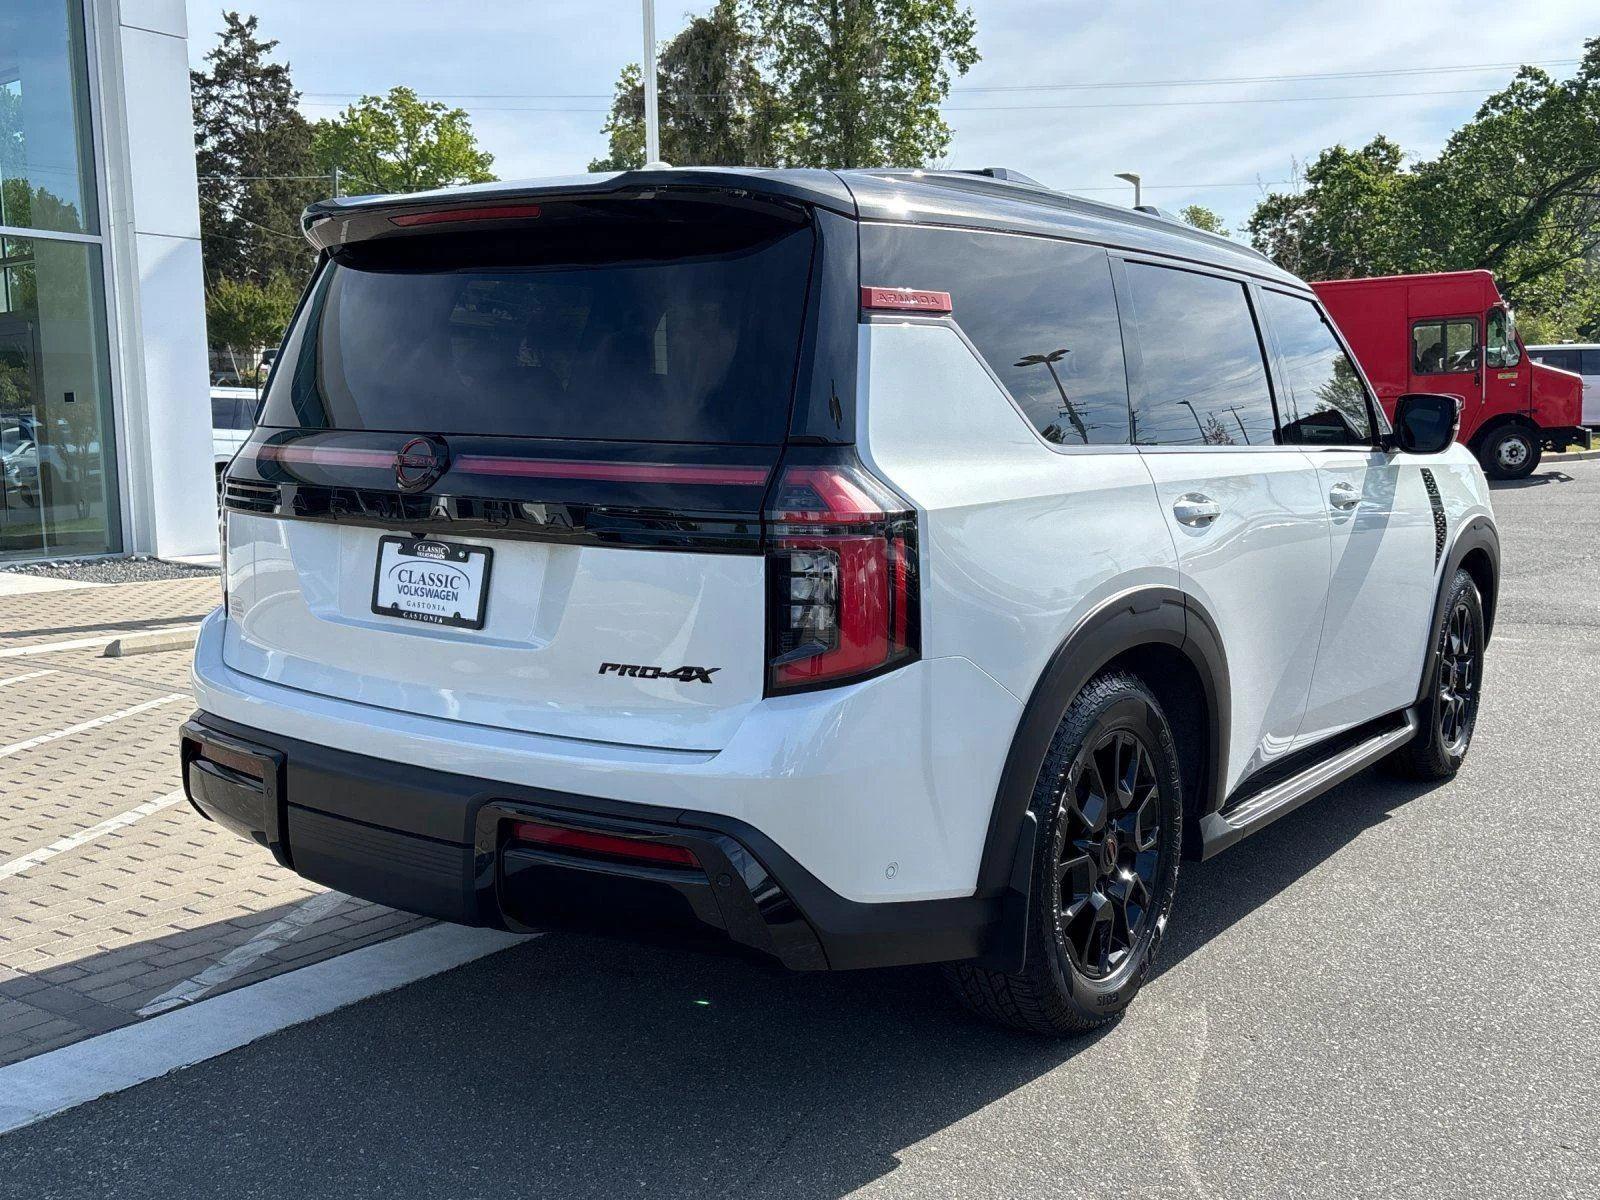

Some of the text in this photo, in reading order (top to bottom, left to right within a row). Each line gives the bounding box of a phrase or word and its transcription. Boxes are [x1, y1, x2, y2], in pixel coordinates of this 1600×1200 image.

[876, 292, 940, 305] ARMADA
[417, 544, 446, 555] CLASSIC
[397, 569, 460, 589] CLASSIC
[397, 583, 459, 602] VOLKSWAGEN
[406, 600, 446, 612] GASTONIA
[402, 611, 443, 624] GASTONIA
[598, 662, 722, 684] PRO-4X
